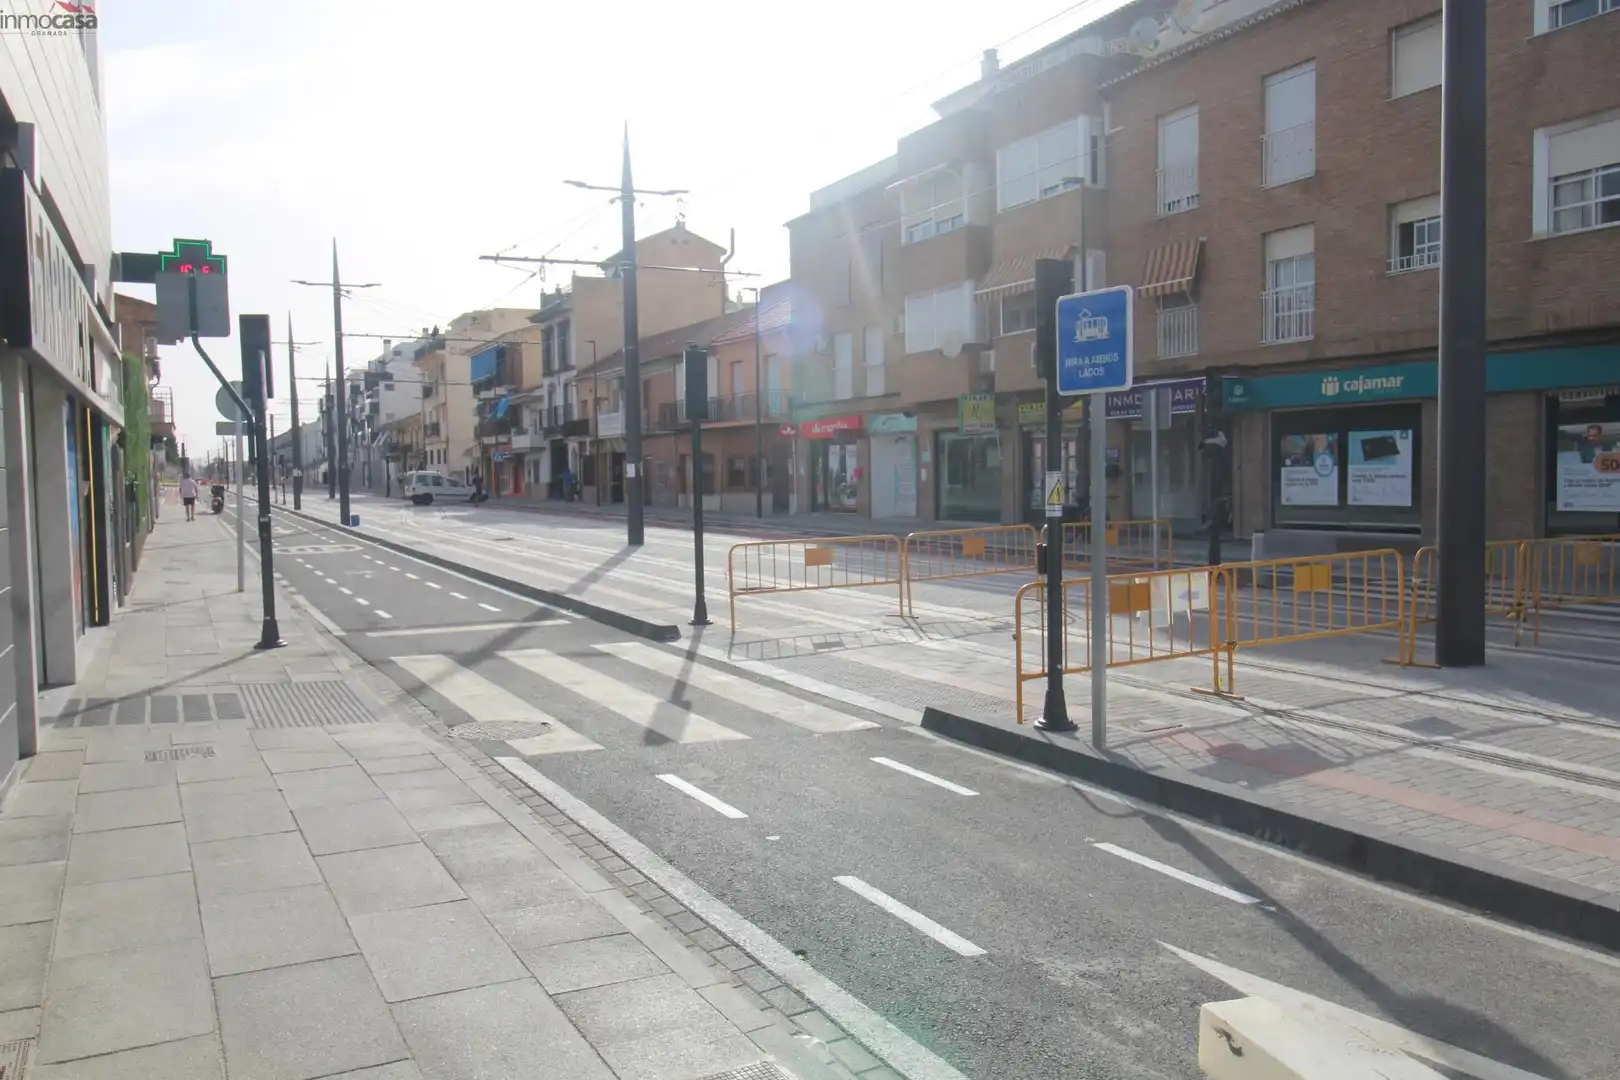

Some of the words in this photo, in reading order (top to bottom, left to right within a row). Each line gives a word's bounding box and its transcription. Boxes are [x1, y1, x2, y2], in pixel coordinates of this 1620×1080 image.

[1084, 356, 1090, 366] A
[1091, 352, 1119, 365] AMBOS
[1078, 366, 1106, 378] LADOS
[1343, 375, 1404, 395] cajamar
